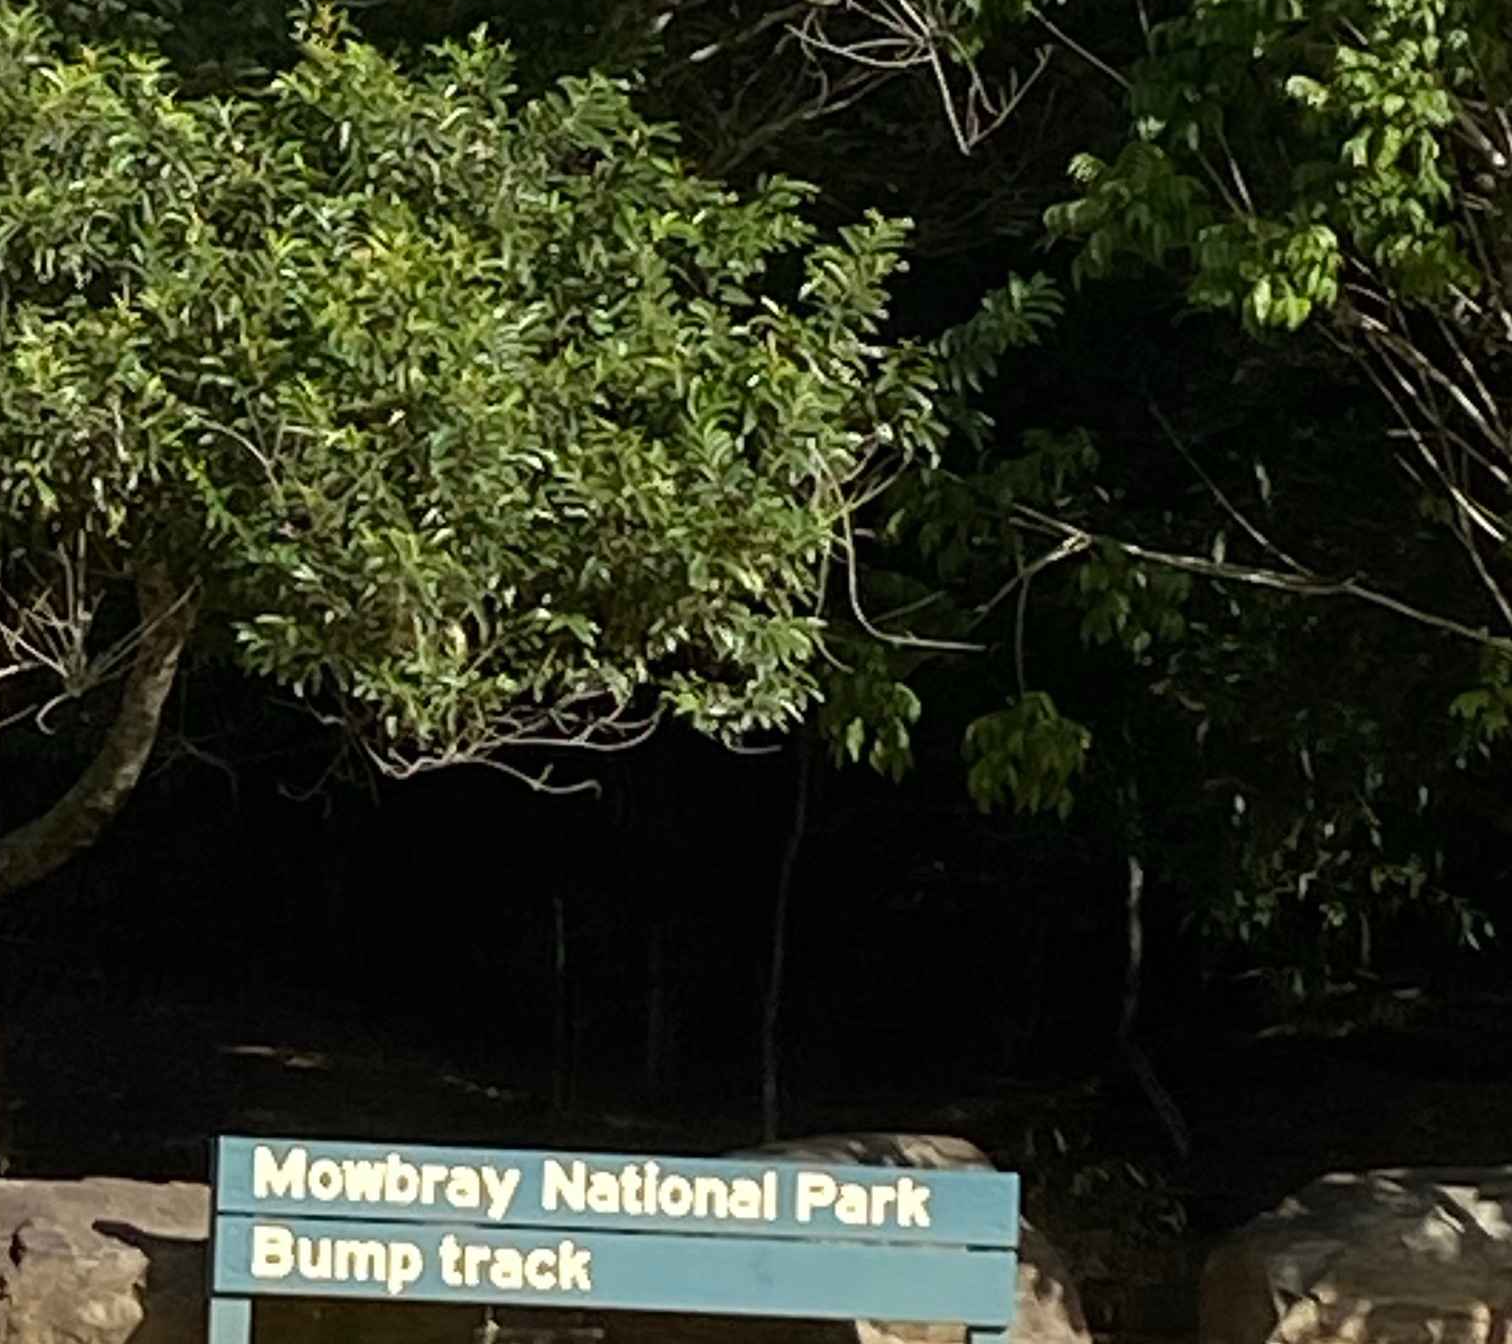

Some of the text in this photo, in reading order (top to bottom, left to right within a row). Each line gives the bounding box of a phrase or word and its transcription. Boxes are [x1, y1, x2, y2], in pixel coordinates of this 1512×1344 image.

[251, 1144, 932, 1229] Mowbray National Park
[249, 1224, 593, 1297] Bump track
